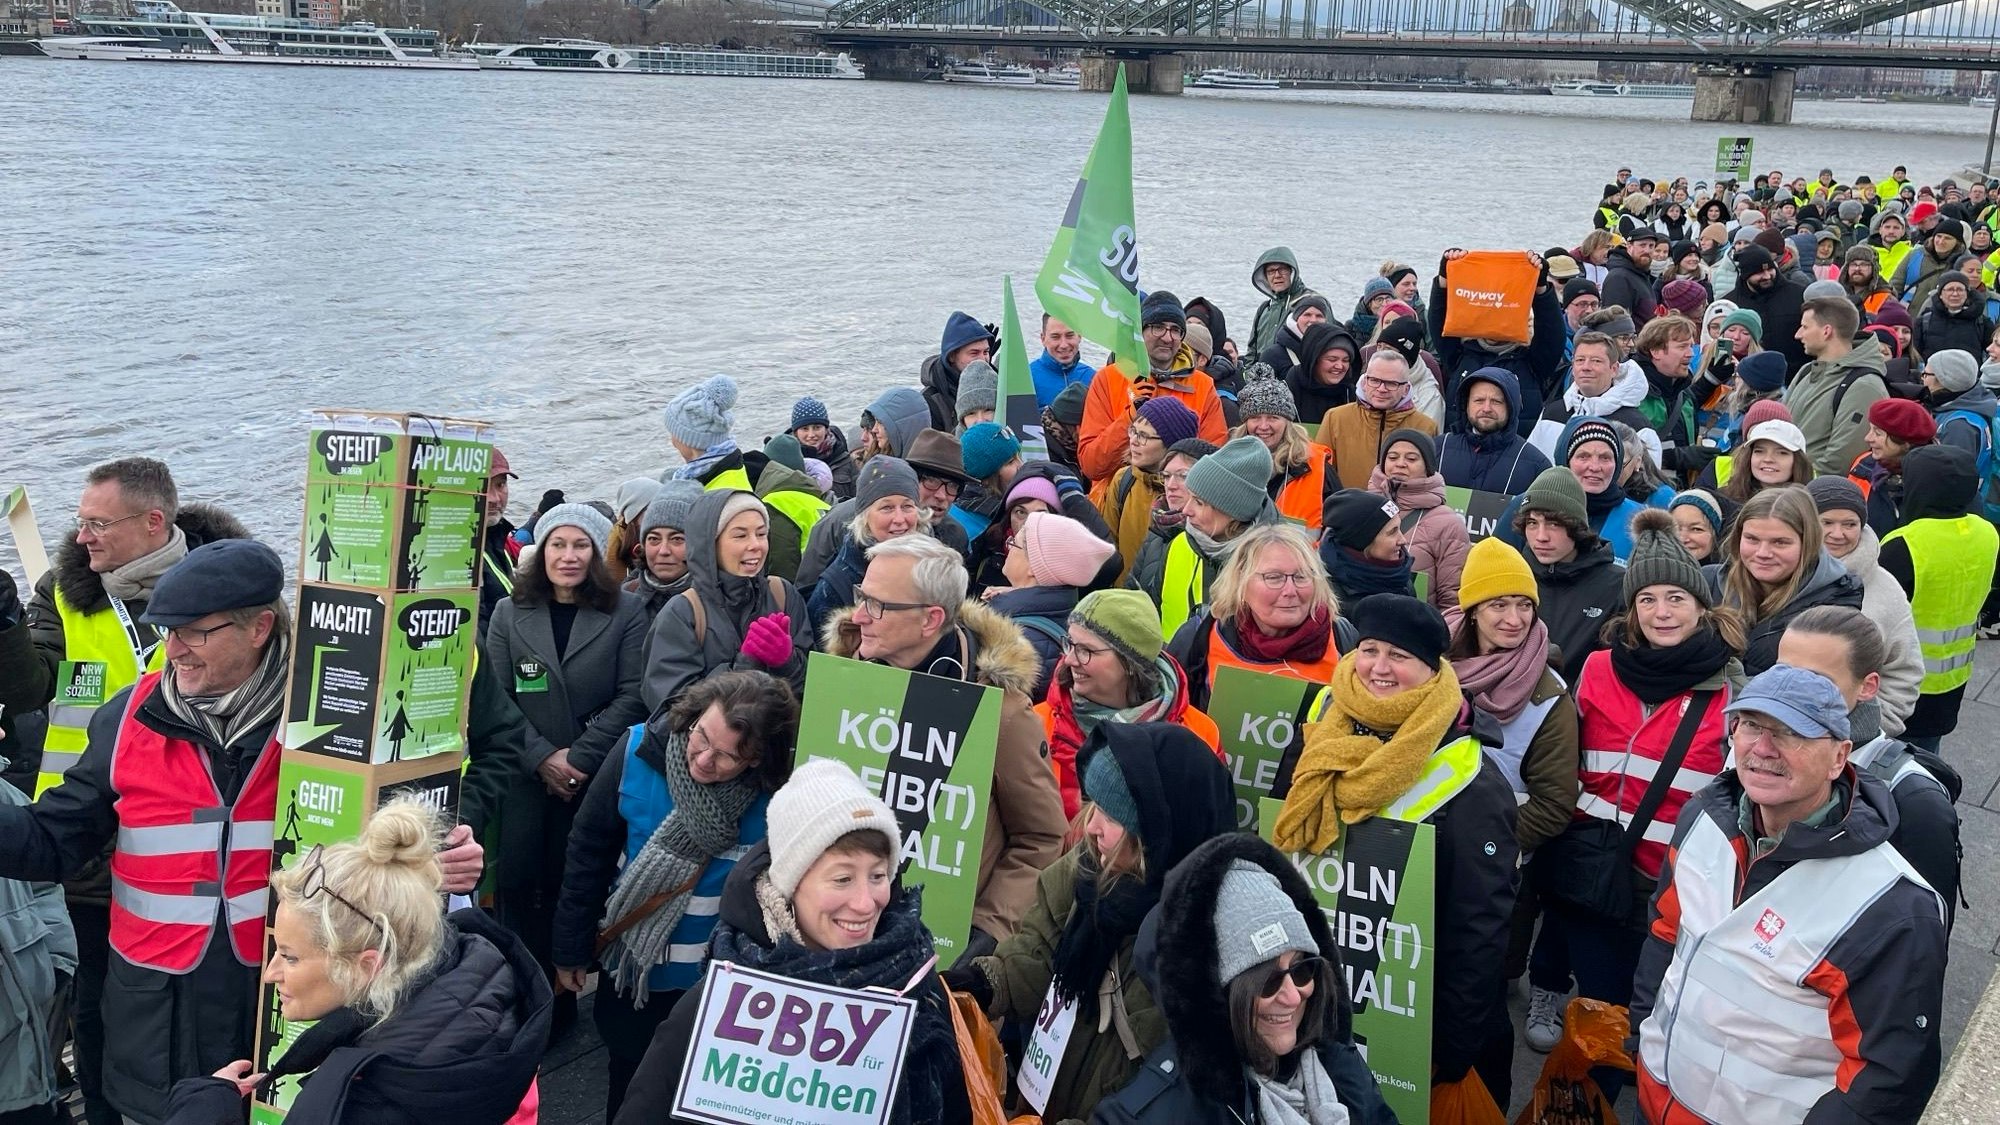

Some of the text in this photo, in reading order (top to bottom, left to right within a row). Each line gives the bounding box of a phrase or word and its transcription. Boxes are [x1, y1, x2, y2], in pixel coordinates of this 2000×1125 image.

[1719, 160, 1748, 168] SOZIAL!
[1455, 287, 1505, 302] anyway
[326, 435, 381, 463] STEHT!
[411, 443, 489, 474] APPLAUS!
[310, 601, 372, 636] MACHT!
[408, 609, 461, 637] STEHT!
[75, 675, 102, 686] BLEIB
[80, 664, 104, 675] NRW
[520, 663, 538, 673] VIEL!
[65, 686, 101, 698] SOZIAL!
[837, 706, 957, 768] KÖLN
[298, 779, 344, 815] GEHT!
[862, 1055, 885, 1072] für
[701, 1047, 878, 1115] Mädchen
[694, 1096, 795, 1125] gemeinnütziger und
